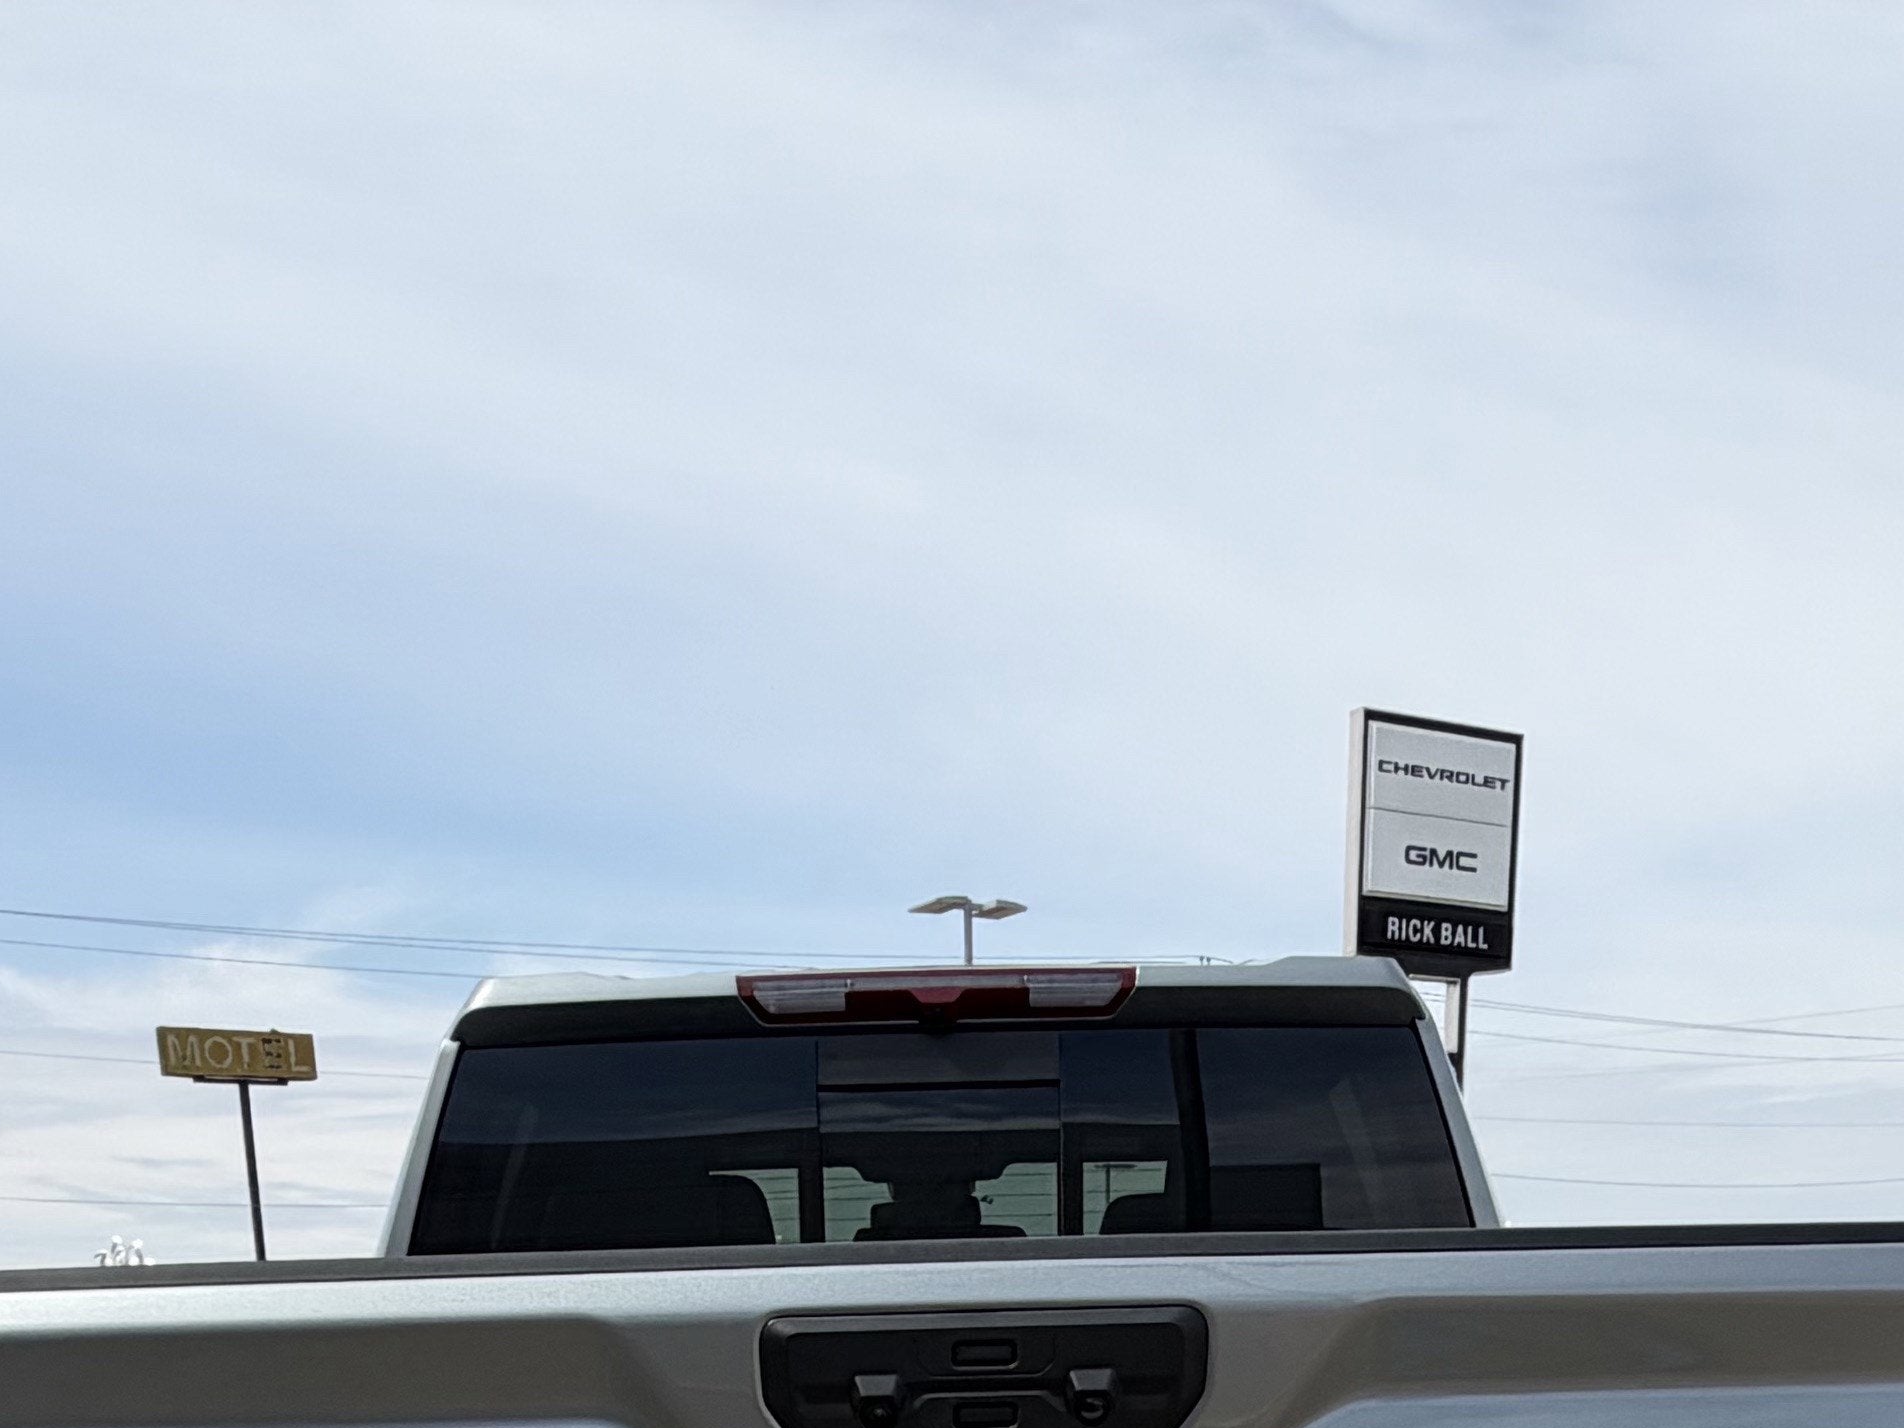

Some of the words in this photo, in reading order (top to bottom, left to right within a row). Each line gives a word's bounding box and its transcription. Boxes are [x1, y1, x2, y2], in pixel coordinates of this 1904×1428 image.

[1377, 759, 1511, 791] CHEVROLET
[1404, 845, 1479, 873] GMC
[1386, 916, 1436, 944] RICK
[1440, 922, 1489, 950] BALL
[166, 1032, 312, 1073] MOTEL
